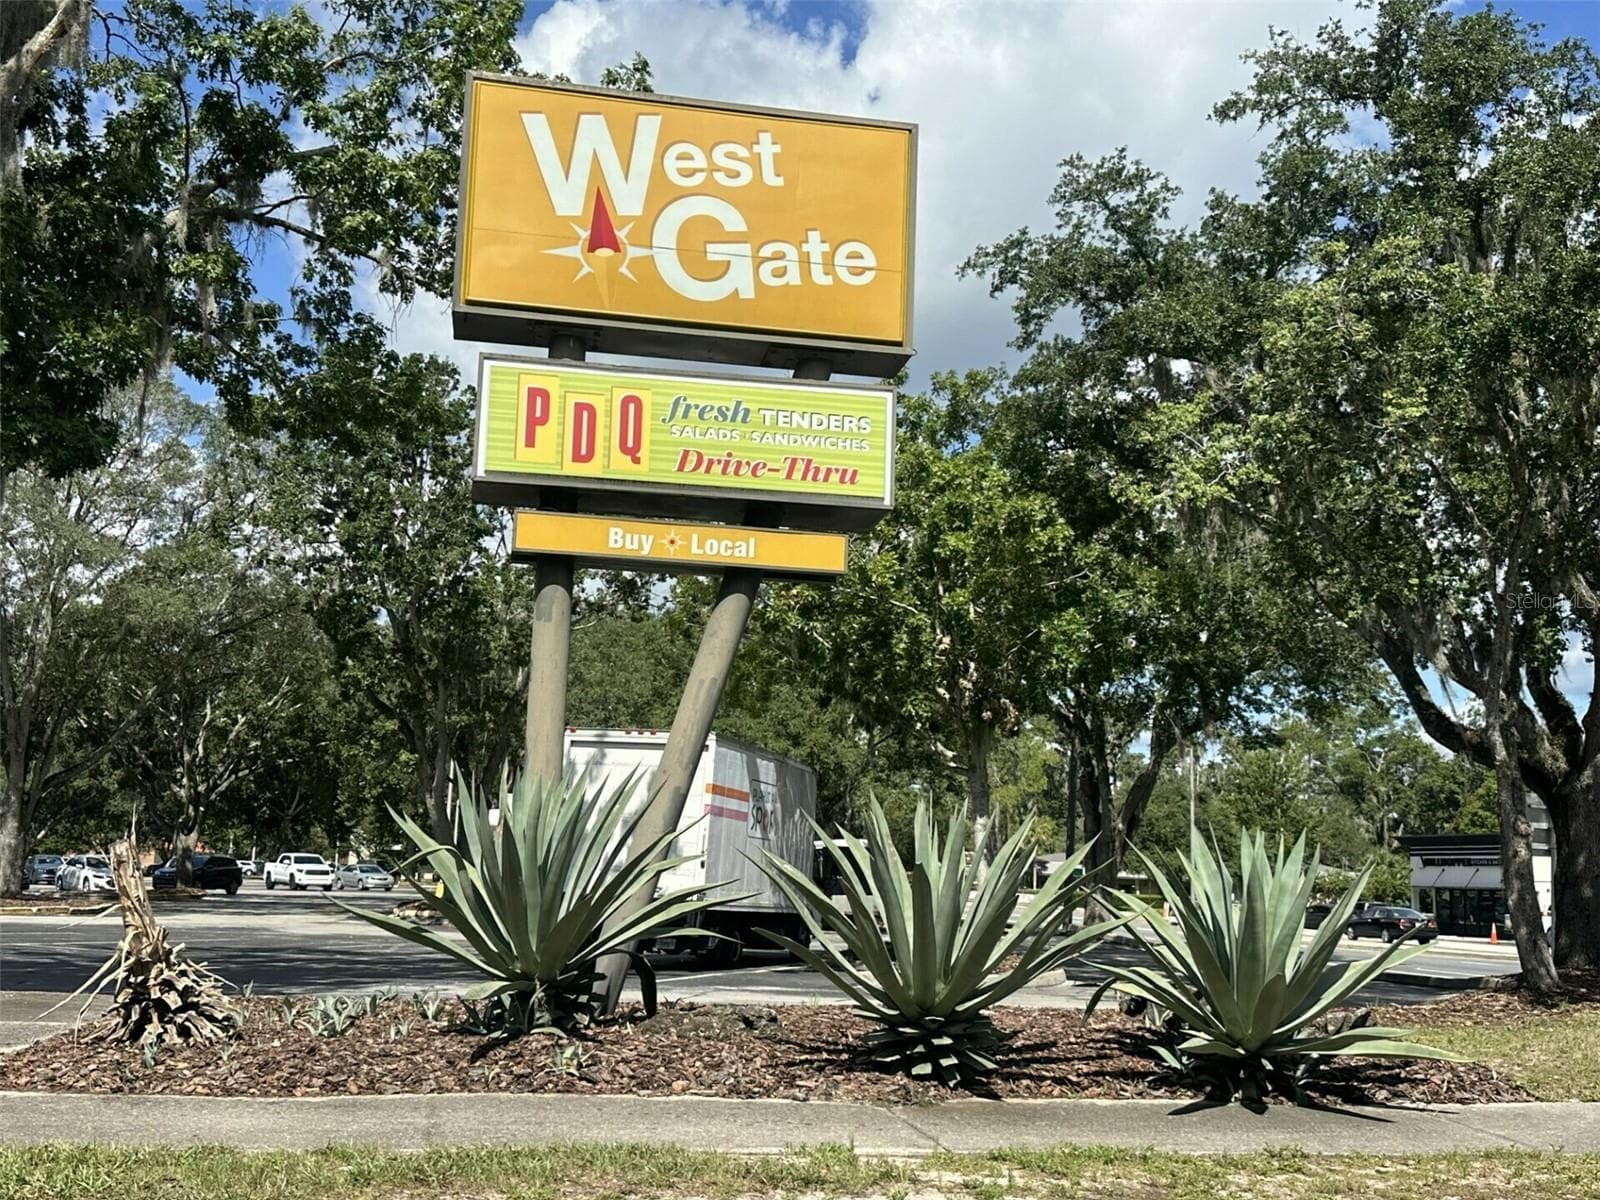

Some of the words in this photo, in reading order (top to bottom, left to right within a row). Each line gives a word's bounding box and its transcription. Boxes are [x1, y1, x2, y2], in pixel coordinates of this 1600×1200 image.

[520, 112, 784, 217] West
[652, 195, 877, 302] Gate
[524, 386, 643, 464] PDQ
[661, 395, 751, 424] fresh
[758, 408, 872, 434] TENDERS
[670, 424, 740, 442] SALADS
[751, 431, 870, 452] SANDWICHES
[675, 449, 860, 485] Drive-Thru
[608, 527, 654, 555] Buy
[691, 534, 755, 558] Local
